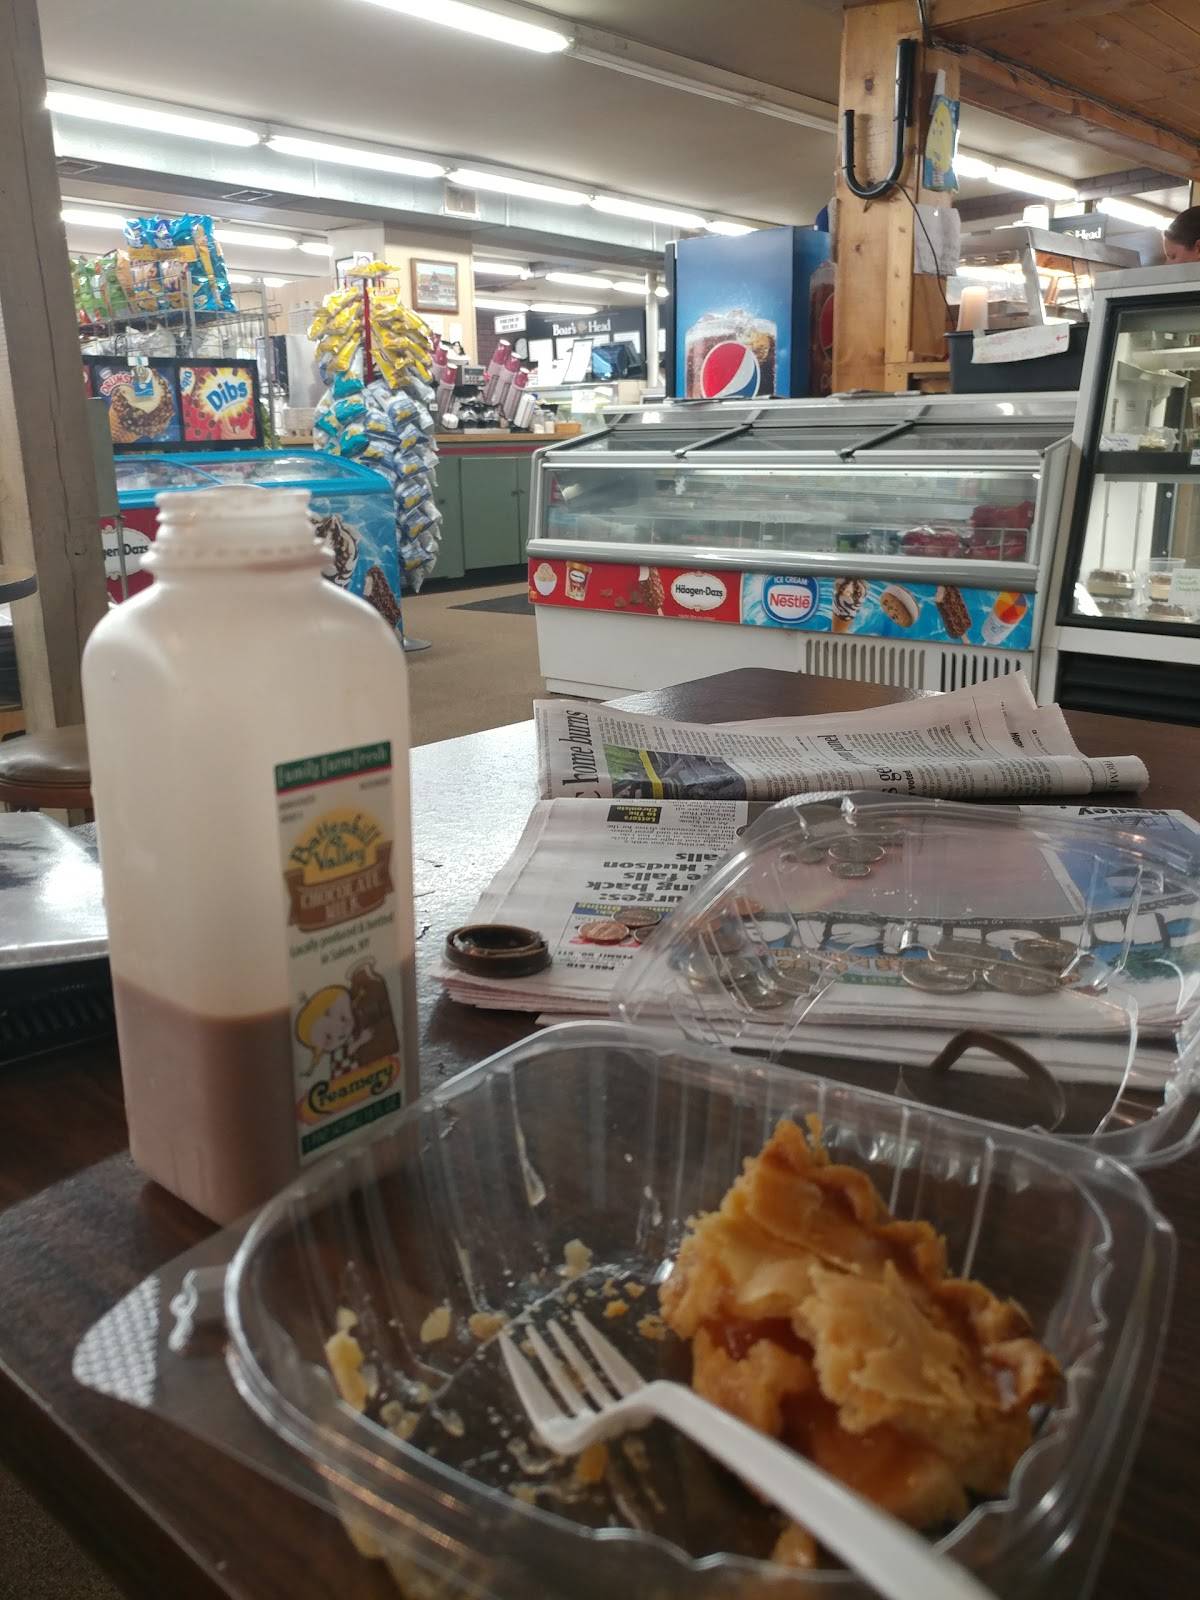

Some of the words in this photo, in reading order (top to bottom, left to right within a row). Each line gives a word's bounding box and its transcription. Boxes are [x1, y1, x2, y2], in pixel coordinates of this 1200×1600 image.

[1075, 227, 1102, 240] Head
[552, 322, 577, 336] Boar's
[588, 318, 611, 333] Head
[206, 380, 248, 412] Dibs
[774, 576, 784, 584] ICE
[785, 576, 808, 586] CREAM
[558, 710, 593, 746] burns
[277, 758, 320, 786] Family
[320, 756, 351, 778] Farm
[351, 744, 386, 771] Fresh
[562, 746, 599, 786] home
[314, 850, 365, 871] Valley
[603, 861, 697, 872] Hudson
[676, 853, 719, 863] alls
[623, 872, 678, 882] falls
[586, 881, 648, 892] back
[308, 1062, 395, 1115] Creamery
